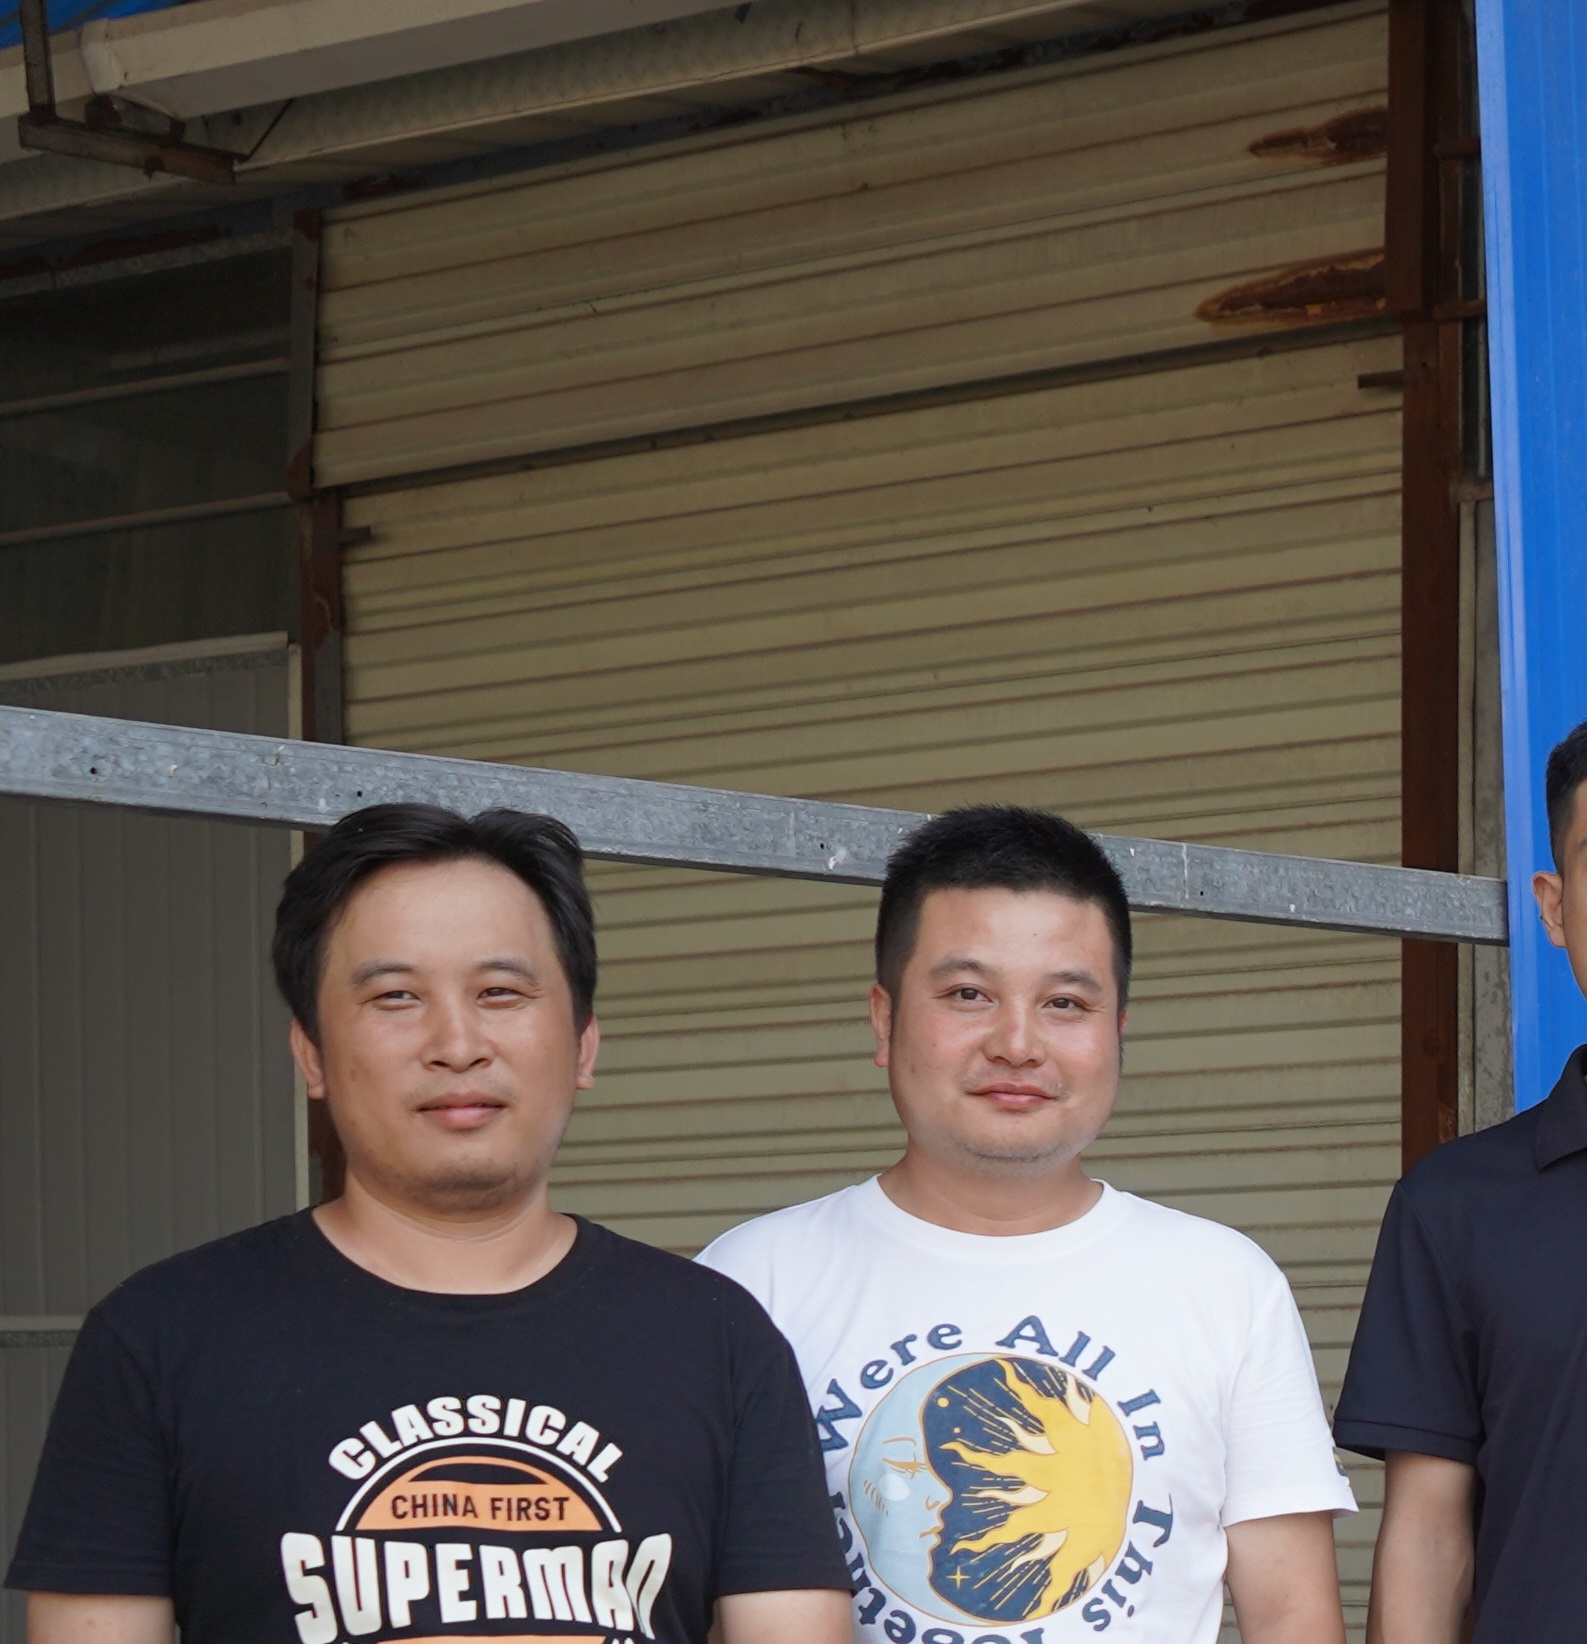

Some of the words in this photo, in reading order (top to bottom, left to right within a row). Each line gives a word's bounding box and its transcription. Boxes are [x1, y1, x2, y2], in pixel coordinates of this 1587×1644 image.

[814, 1322, 963, 1453] Were
[995, 1315, 1116, 1382] All
[328, 1394, 622, 1483] CLASSICAL
[1116, 1388, 1165, 1461] In
[390, 1493, 479, 1521] CHINA
[489, 1495, 570, 1522] FIRST
[1081, 1493, 1175, 1632] This
